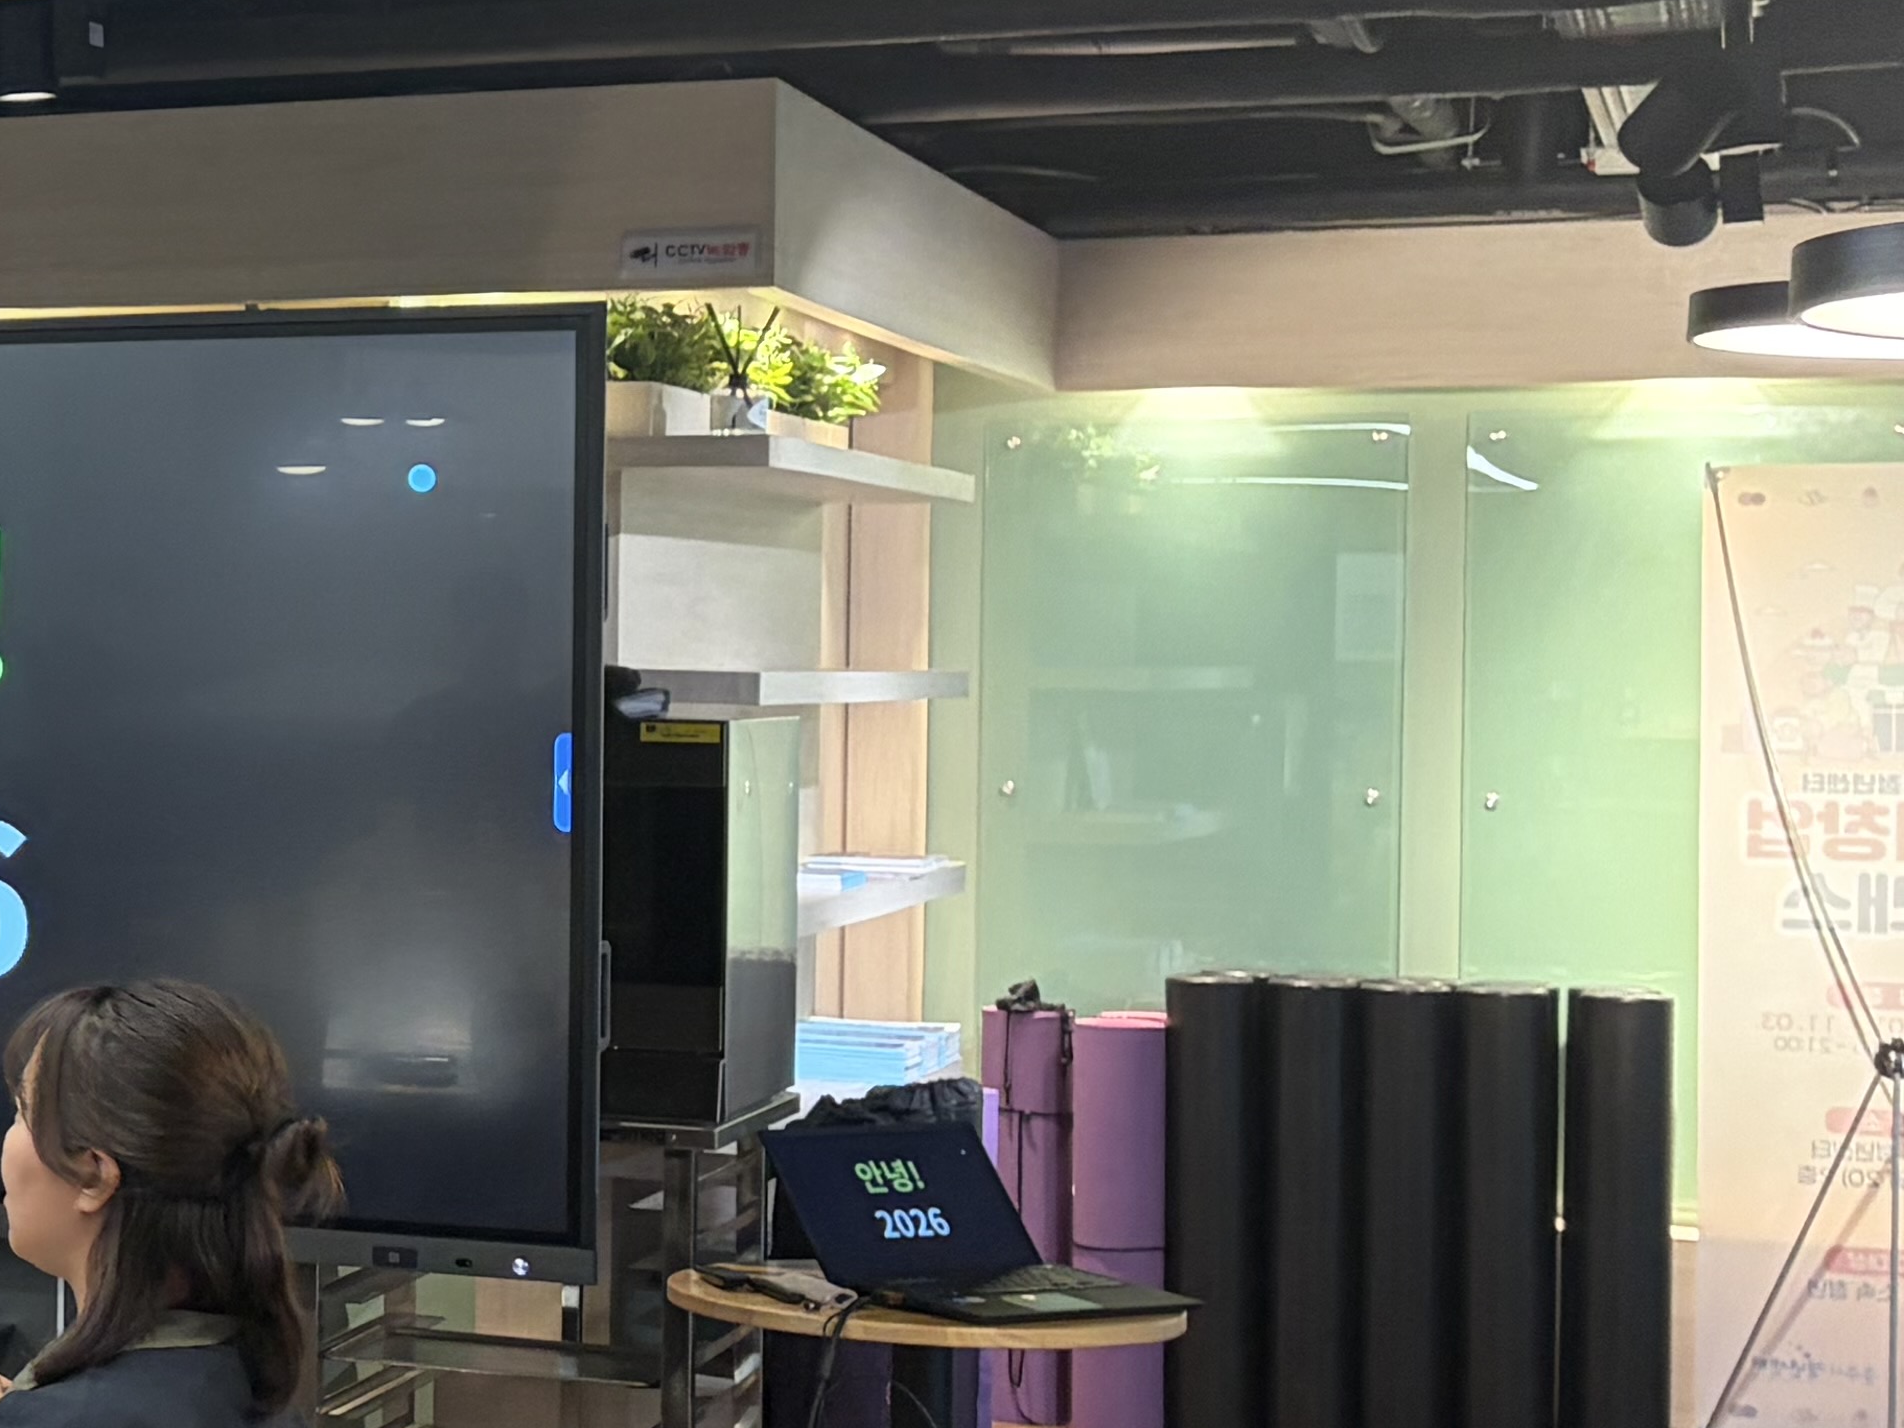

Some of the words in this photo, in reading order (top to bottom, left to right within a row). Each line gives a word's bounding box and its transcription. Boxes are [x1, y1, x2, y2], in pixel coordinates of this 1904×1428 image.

[665, 243, 706, 258] CCTV
[854, 1158, 926, 1194] 안녕!
[874, 1206, 951, 1239] 2026
